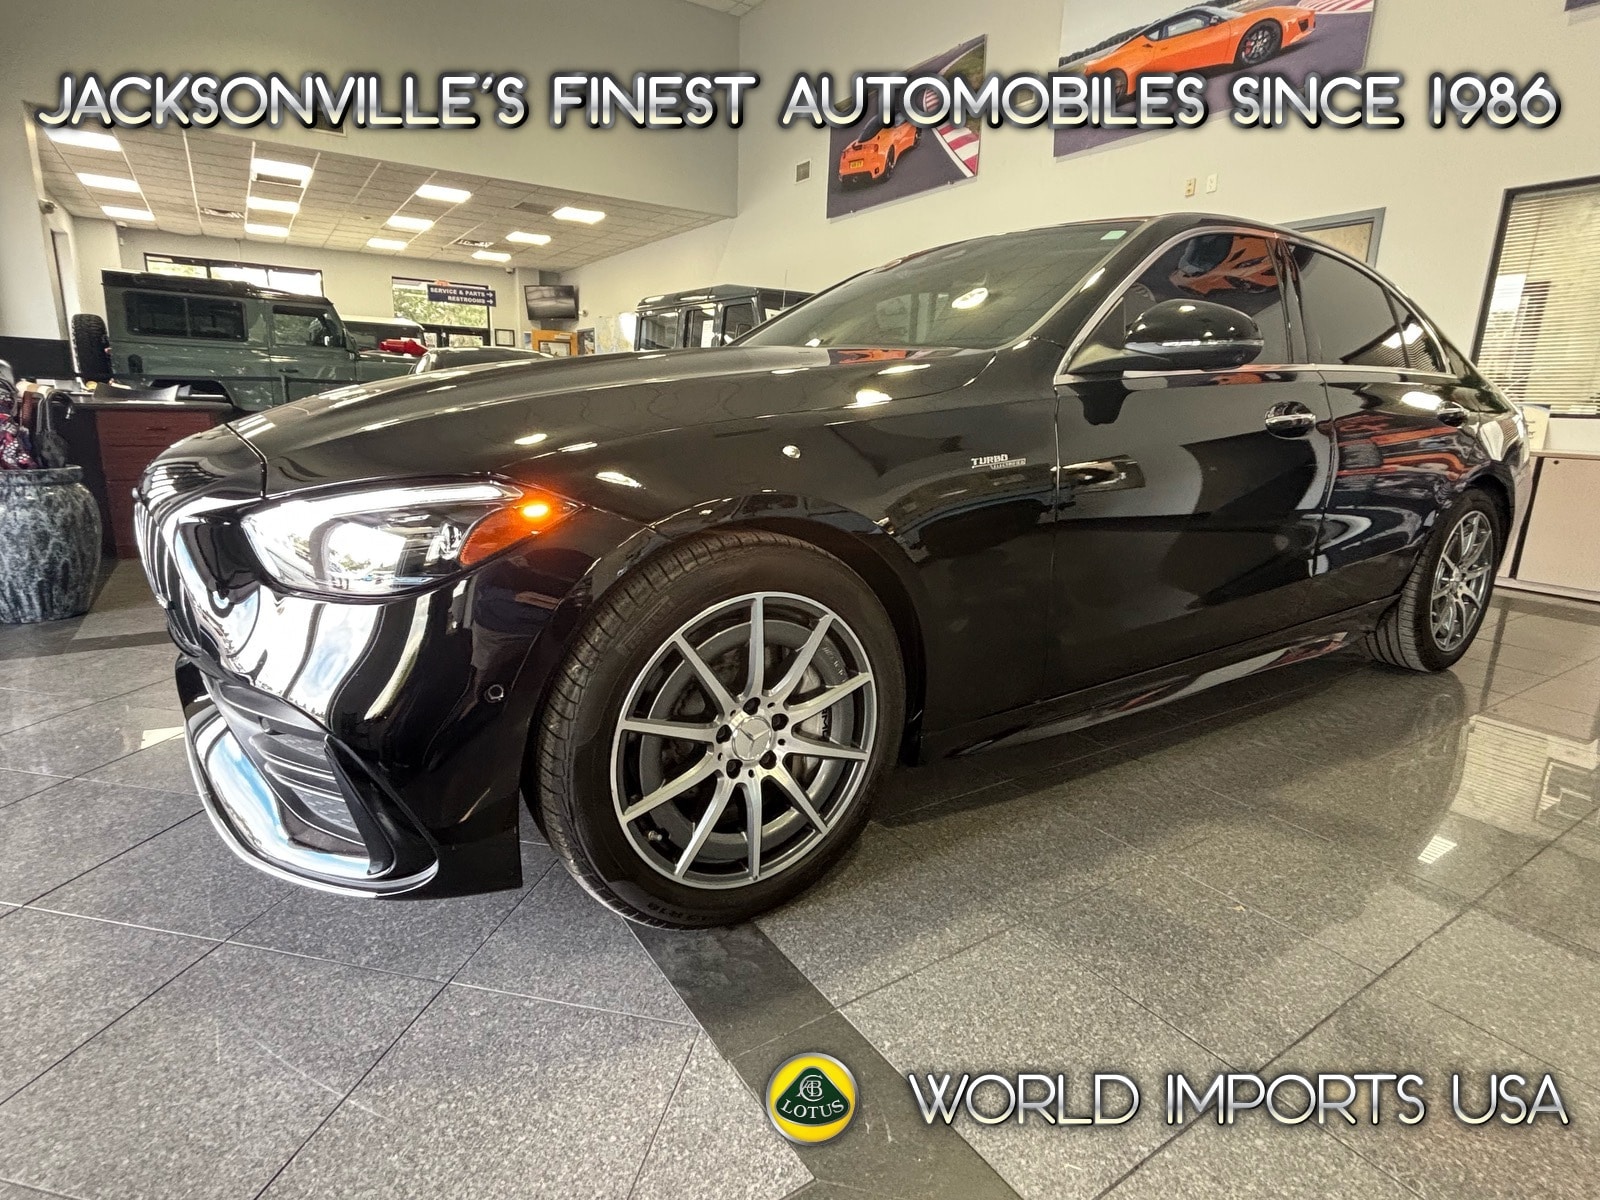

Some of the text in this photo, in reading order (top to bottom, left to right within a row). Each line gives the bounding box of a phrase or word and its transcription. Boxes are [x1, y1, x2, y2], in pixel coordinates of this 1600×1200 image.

[430, 287, 457, 295] SERVICE
[447, 295, 486, 304] RESTROOMS
[970, 453, 1008, 466] TURBO
